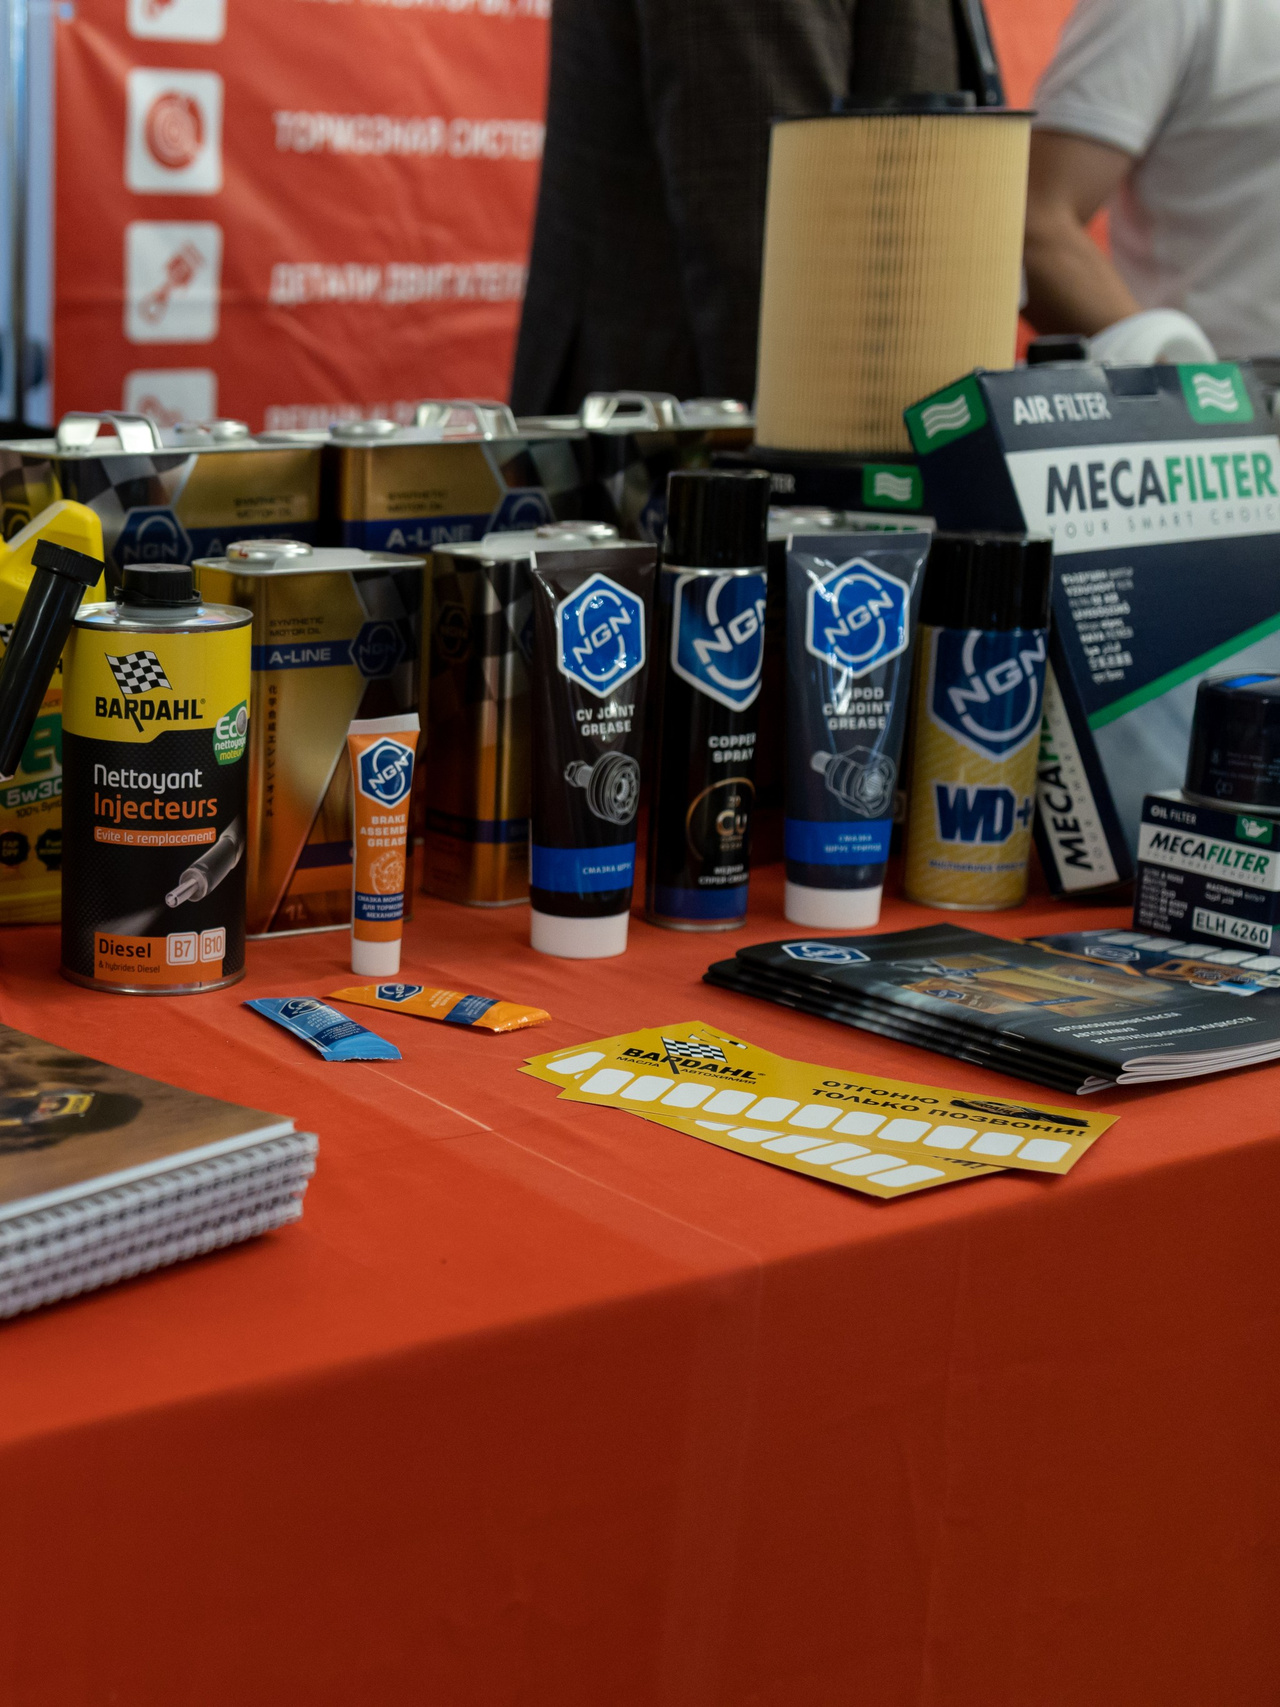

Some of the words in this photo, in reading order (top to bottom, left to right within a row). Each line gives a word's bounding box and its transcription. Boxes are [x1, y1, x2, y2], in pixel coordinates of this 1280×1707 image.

[1013, 395, 1054, 426] AIR
[1055, 391, 1112, 422] FILTER
[1046, 452, 1278, 517] MECAFILTER
[386, 524, 474, 549] A-LINE
[823, 591, 894, 645] NGN
[573, 606, 633, 665] NGN
[269, 648, 332, 665] A-LINE
[947, 635, 1046, 713] NGN
[96, 696, 204, 733] BARDAHL
[576, 708, 593, 722] CV
[827, 716, 886, 731] GREASE
[581, 720, 632, 737] GREASE
[214, 736, 247, 752] nettoyage
[94, 763, 203, 795] Nettoyant
[369, 748, 412, 791] NGN
[94, 792, 218, 824] Injecteurs
[371, 813, 406, 825] BRAKE
[1150, 805, 1168, 820] OIL
[1170, 809, 1197, 826] FILTER
[96, 828, 121, 842] Evite
[123, 832, 134, 843] le
[1149, 830, 1271, 875] MECAFILTER
[1195, 911, 1226, 934] ELH
[1230, 921, 1270, 945] 4260
[98, 938, 152, 959] Diesel
[174, 940, 191, 958] B7
[204, 936, 223, 955] B10
[98, 960, 105, 969] &
[105, 961, 136, 974] hybrides
[137, 963, 161, 974] Diesel
[616, 1056, 661, 1068] МАСЛА
[621, 1047, 758, 1081] BARDAHL
[679, 1068, 757, 1086] АВТОХИМИЯ
[821, 1080, 940, 1105] ОТГОНЮ
[811, 1089, 920, 1113] ТОЛЬКО
[927, 1108, 1087, 1138] ПОЗВОНИ!
